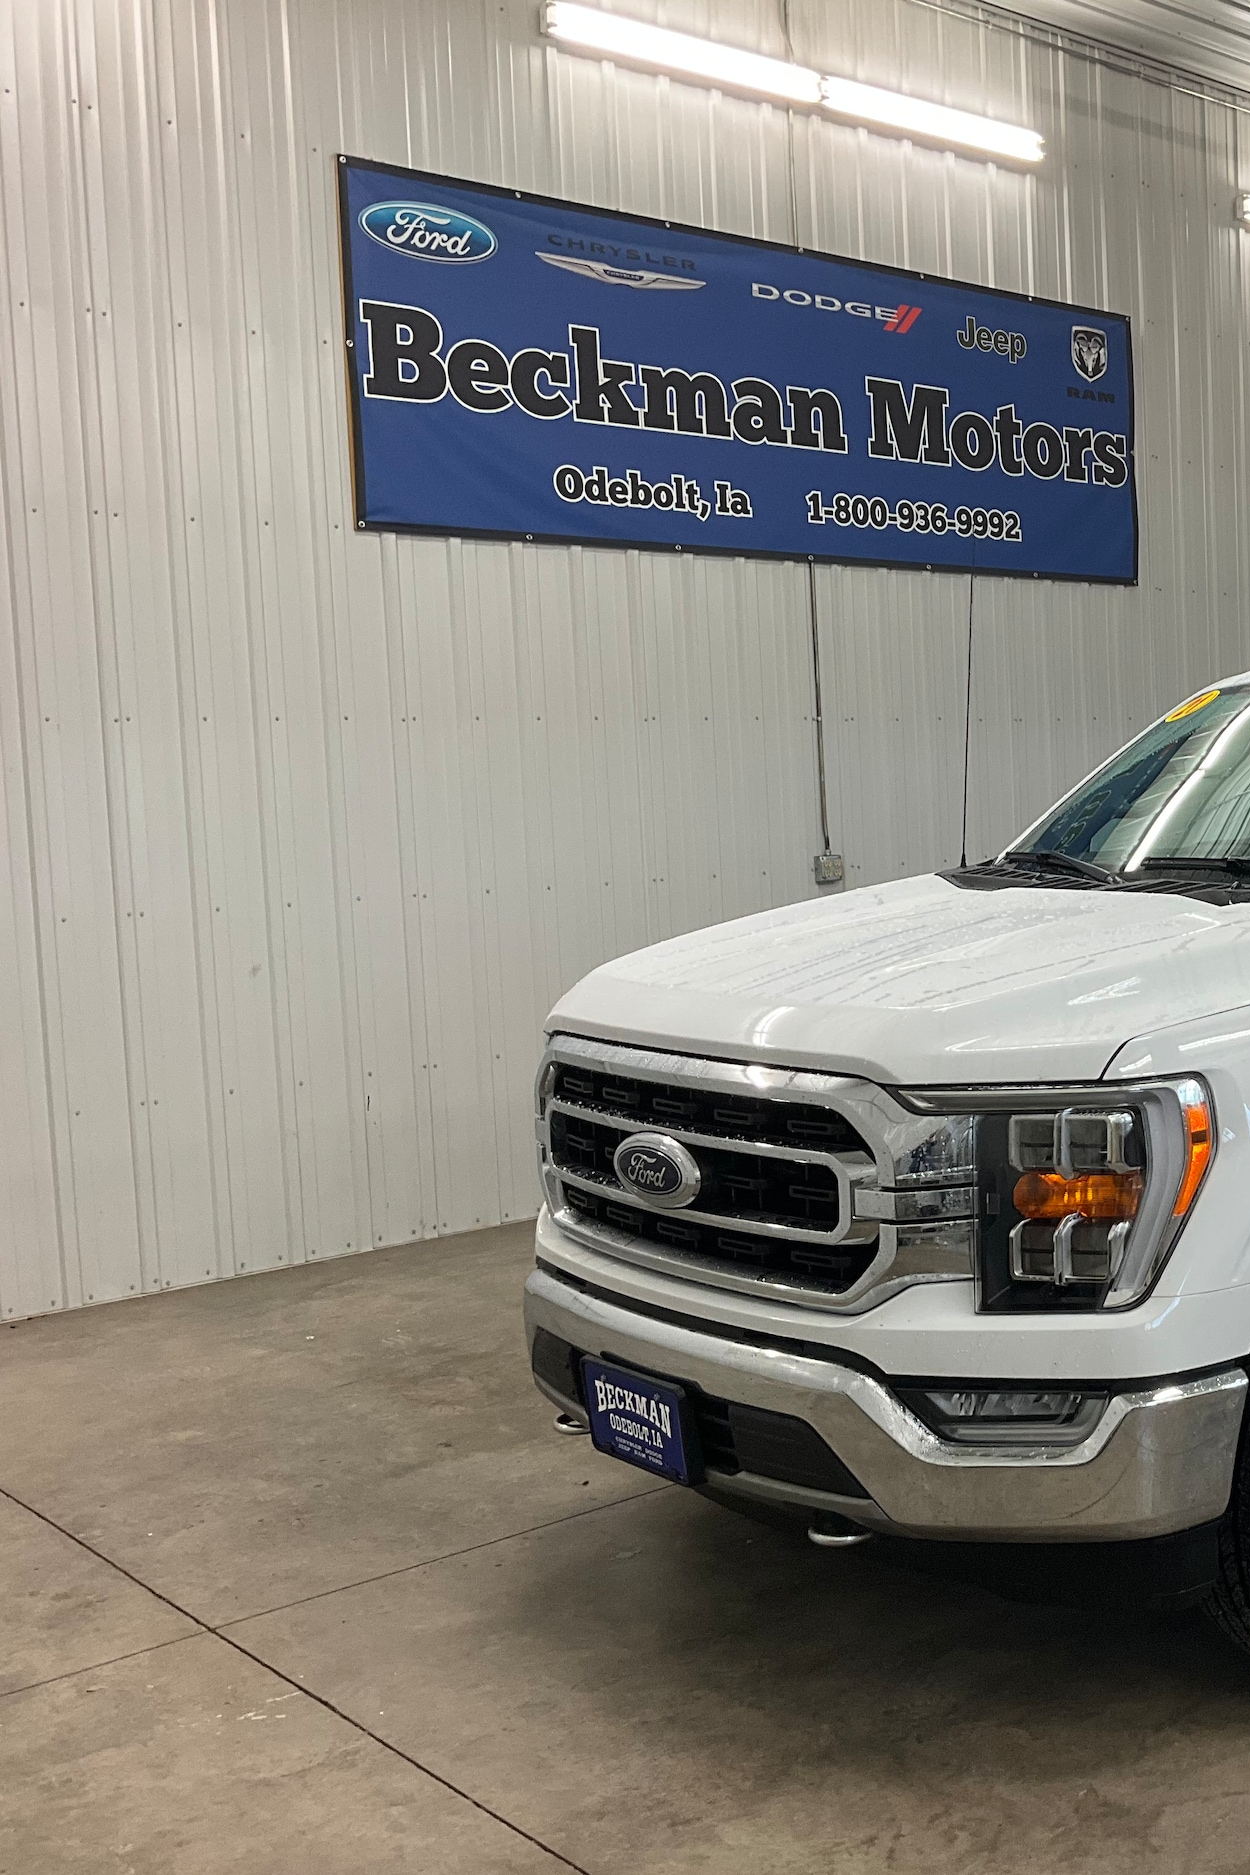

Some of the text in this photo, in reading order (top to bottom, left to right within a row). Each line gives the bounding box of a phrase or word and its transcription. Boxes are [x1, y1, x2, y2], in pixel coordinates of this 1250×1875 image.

[386, 209, 472, 256] Ford
[547, 233, 697, 272] CHRYSLER
[751, 282, 900, 324] DODGE
[956, 316, 1028, 364] Jeep
[359, 298, 1128, 488] Beckman Motors
[1066, 386, 1116, 404] RAM
[805, 490, 1023, 542] 1-800-936-9992
[627, 1152, 667, 1188] Ford
[594, 1379, 672, 1439] BECKMAN
